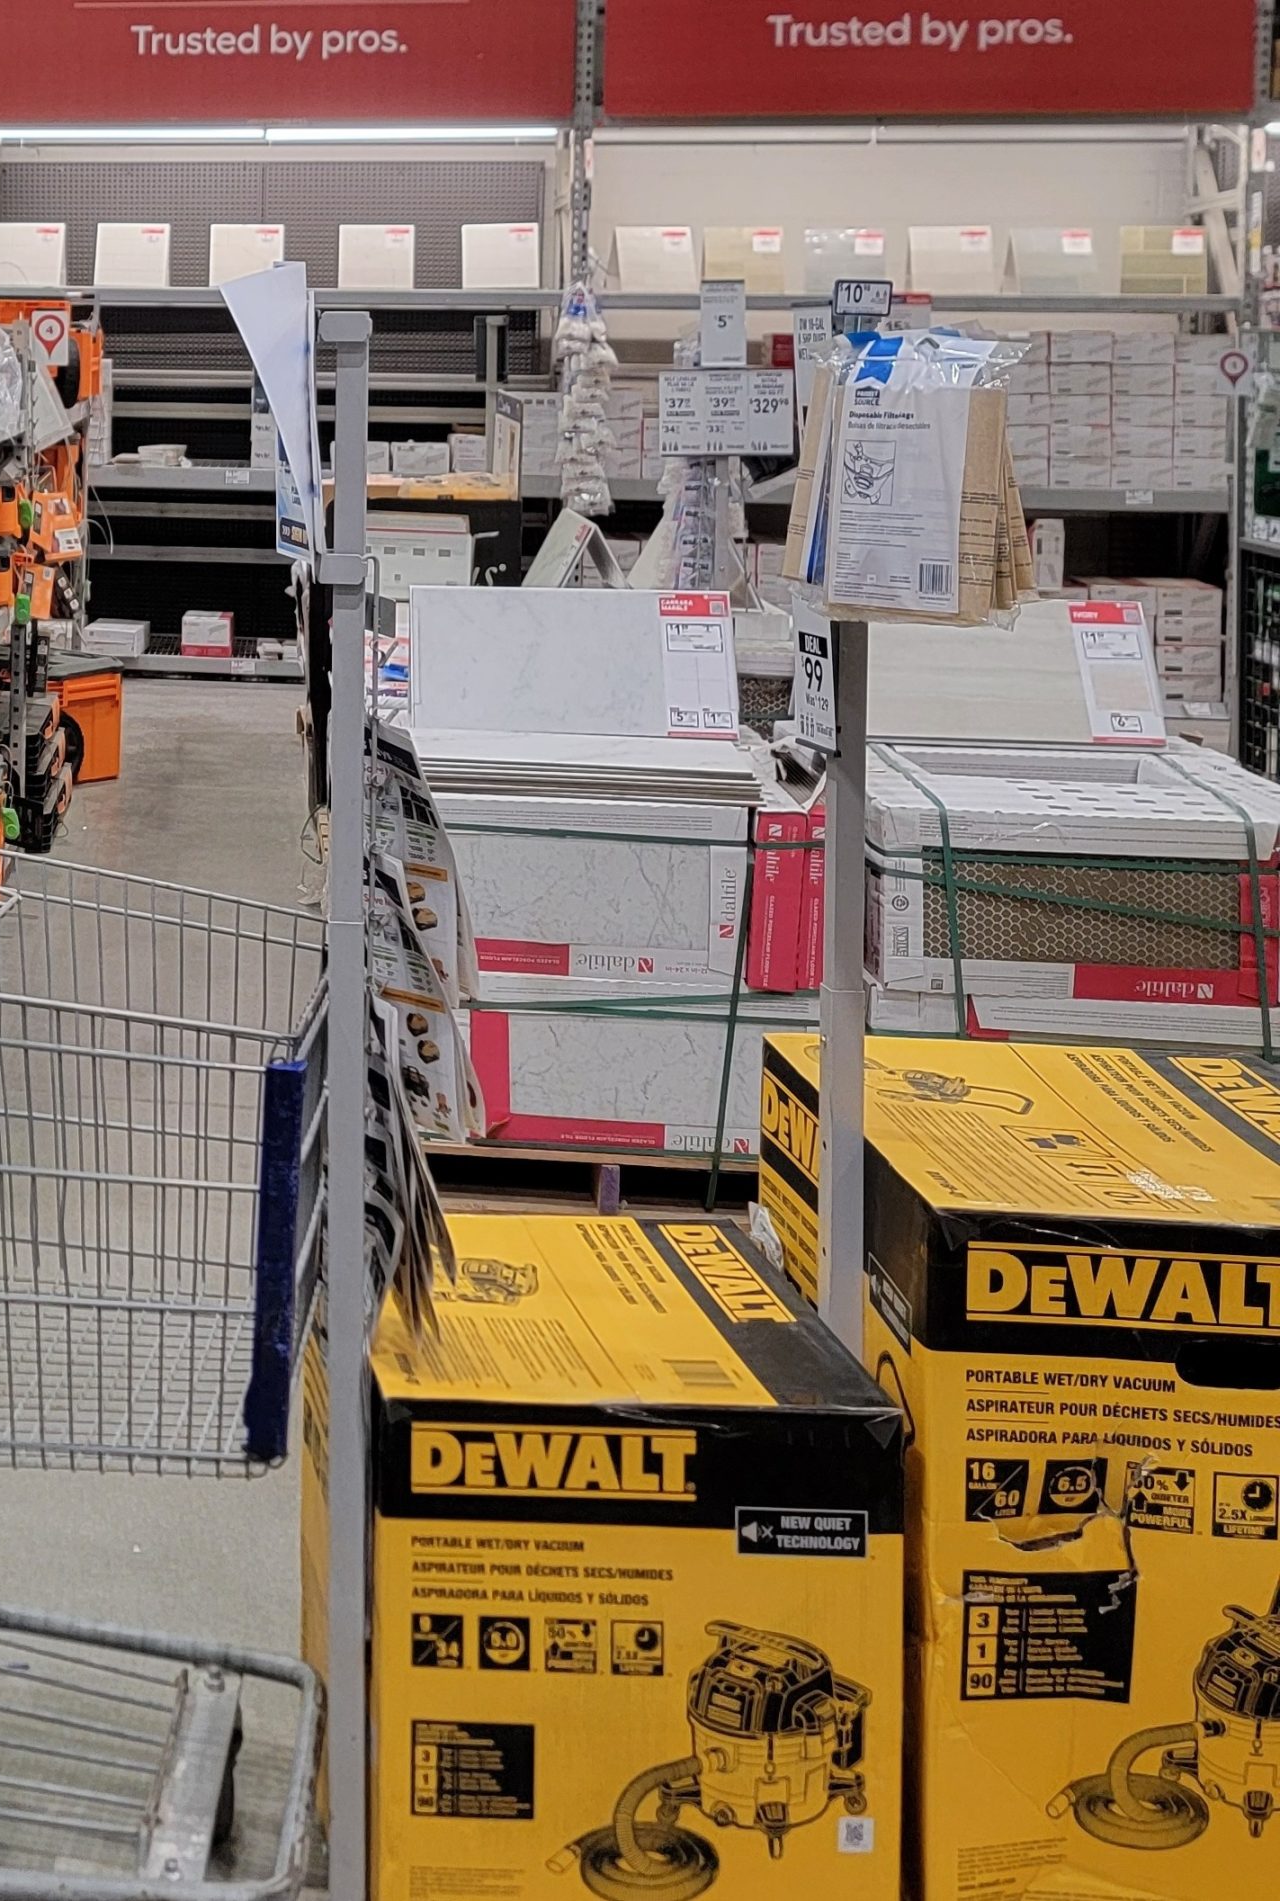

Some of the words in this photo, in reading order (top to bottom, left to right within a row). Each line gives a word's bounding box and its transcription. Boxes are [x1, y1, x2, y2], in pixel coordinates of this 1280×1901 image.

[767, 13, 911, 47] Trusted
[921, 14, 968, 51] by
[978, 17, 1073, 51] pros.
[130, 24, 260, 55] Trusted
[270, 24, 313, 60] by
[322, 29, 408, 60] pros.
[840, 284, 863, 303] $10
[46, 325, 54, 334] 4
[749, 399, 779, 413] $329
[804, 634, 822, 655] DEAL
[801, 656, 823, 692] $99
[720, 868, 737, 922] daltile
[577, 953, 635, 971] daltile
[1135, 980, 1194, 997] daltile
[966, 1369, 1039, 1385] PORTABLE
[1043, 1372, 1108, 1388] WET/DRY
[1114, 1376, 1176, 1393] VACUUM
[966, 1399, 1055, 1415] ASPIRATEUR
[1060, 1402, 1098, 1417] POUR
[1102, 1402, 1168, 1421] DÉCHETS
[1173, 1409, 1280, 1429] SECS/HUMIDES
[966, 1428, 1057, 1443] ASPIRADORA
[1062, 1431, 1098, 1445] PARA
[1177, 1439, 1186, 1451] Y
[1191, 1437, 1253, 1457] SÓLIDOS
[969, 1462, 995, 1480] 16
[1057, 1475, 1087, 1492] 6.5
[994, 1490, 1020, 1507] 60
[780, 1515, 811, 1530] NEW
[814, 1517, 852, 1531] QUIET
[1130, 1514, 1192, 1529] POWERFUL
[1218, 1508, 1248, 1521] 2.5X
[1223, 1525, 1266, 1536] LIFETIME
[411, 1535, 472, 1549] PORTABLE
[475, 1538, 530, 1551] WET/DRY
[534, 1540, 585, 1552] VACUUM
[775, 1534, 860, 1551] TECHNOLOGY
[412, 1561, 486, 1574] ASPIRATEUR
[490, 1564, 521, 1576] POUR
[525, 1562, 579, 1578] DÉCHETS
[583, 1567, 674, 1581] SECS/HUMIDES
[411, 1586, 488, 1600] ASPIRADORA
[492, 1590, 524, 1602] PARA
[528, 1588, 583, 1604] LÍQUIDOS
[587, 1594, 594, 1604] Y
[598, 1591, 649, 1606] SÓLIDOS
[976, 1612, 990, 1629] 3
[976, 1643, 986, 1659] 1
[970, 1673, 993, 1690] 90
